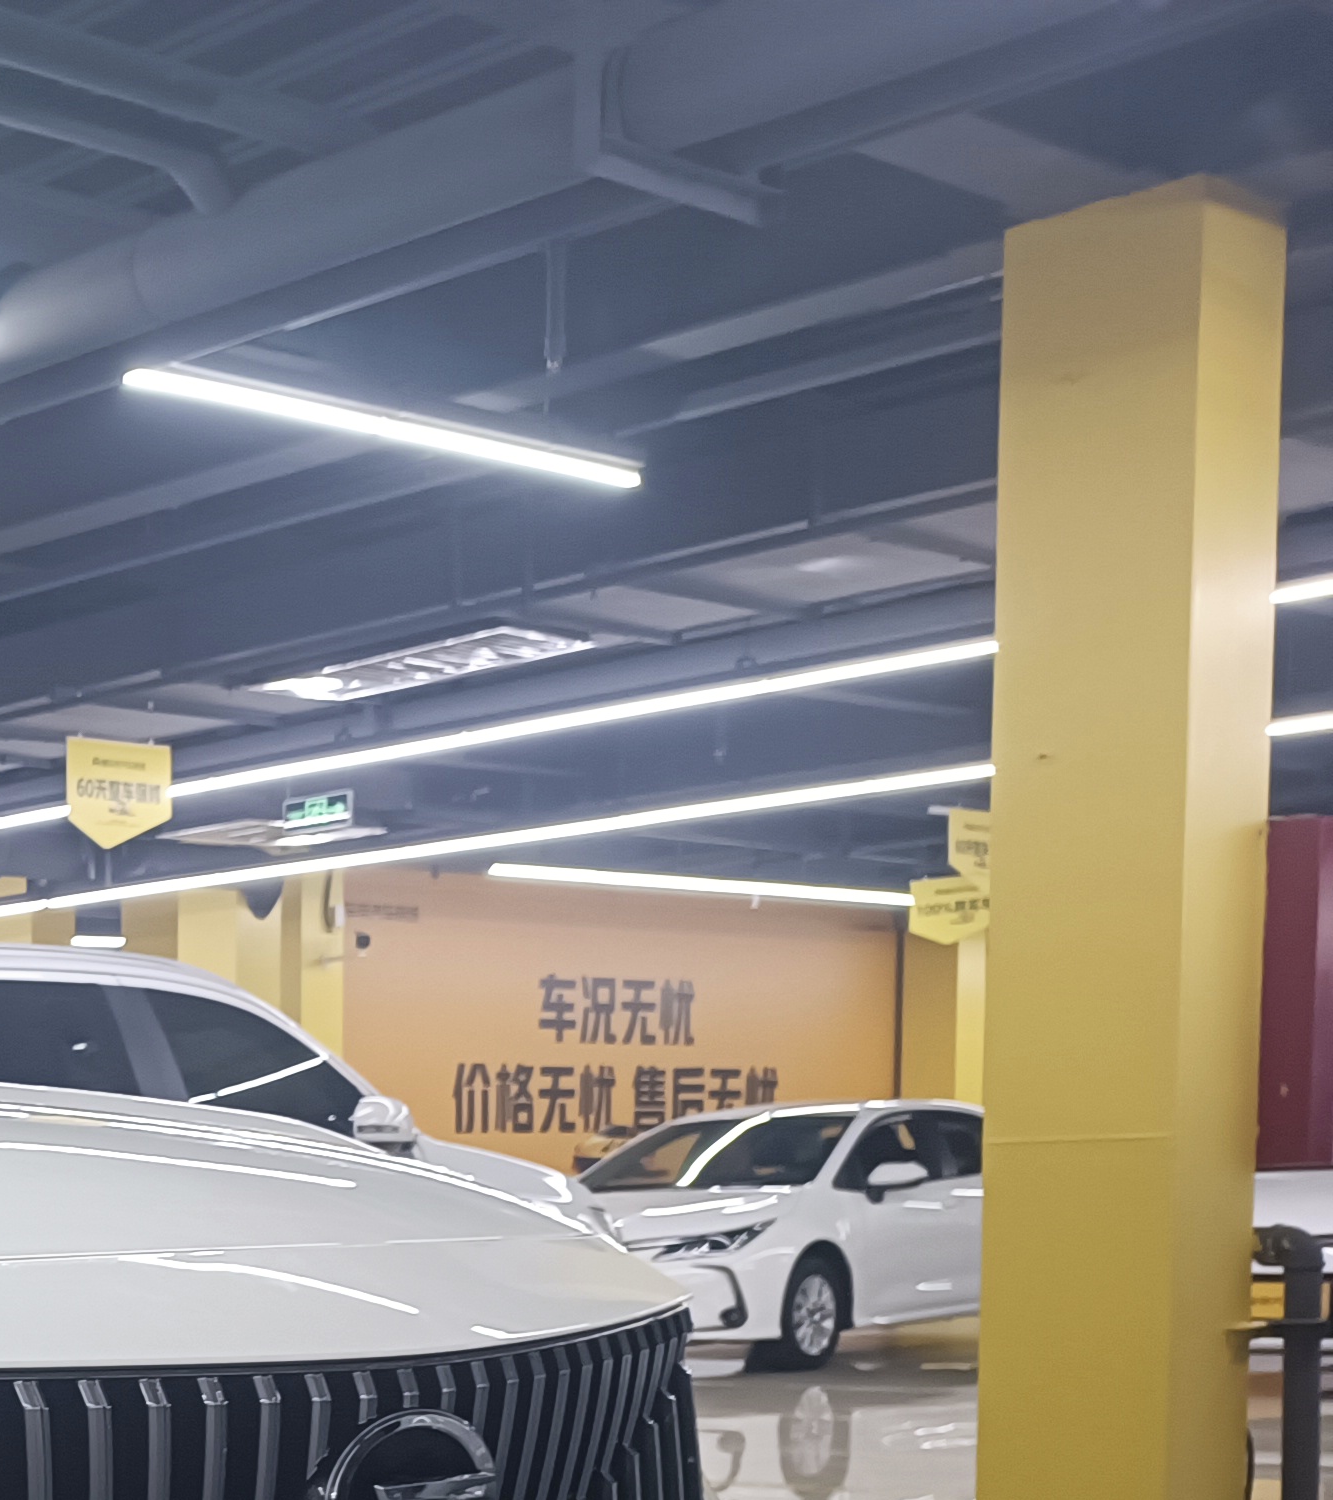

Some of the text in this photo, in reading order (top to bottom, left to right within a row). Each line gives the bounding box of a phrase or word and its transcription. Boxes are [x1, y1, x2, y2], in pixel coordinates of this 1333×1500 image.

[538, 973, 695, 1046] 车况无忧
[452, 1062, 616, 1134] 价格无忧
